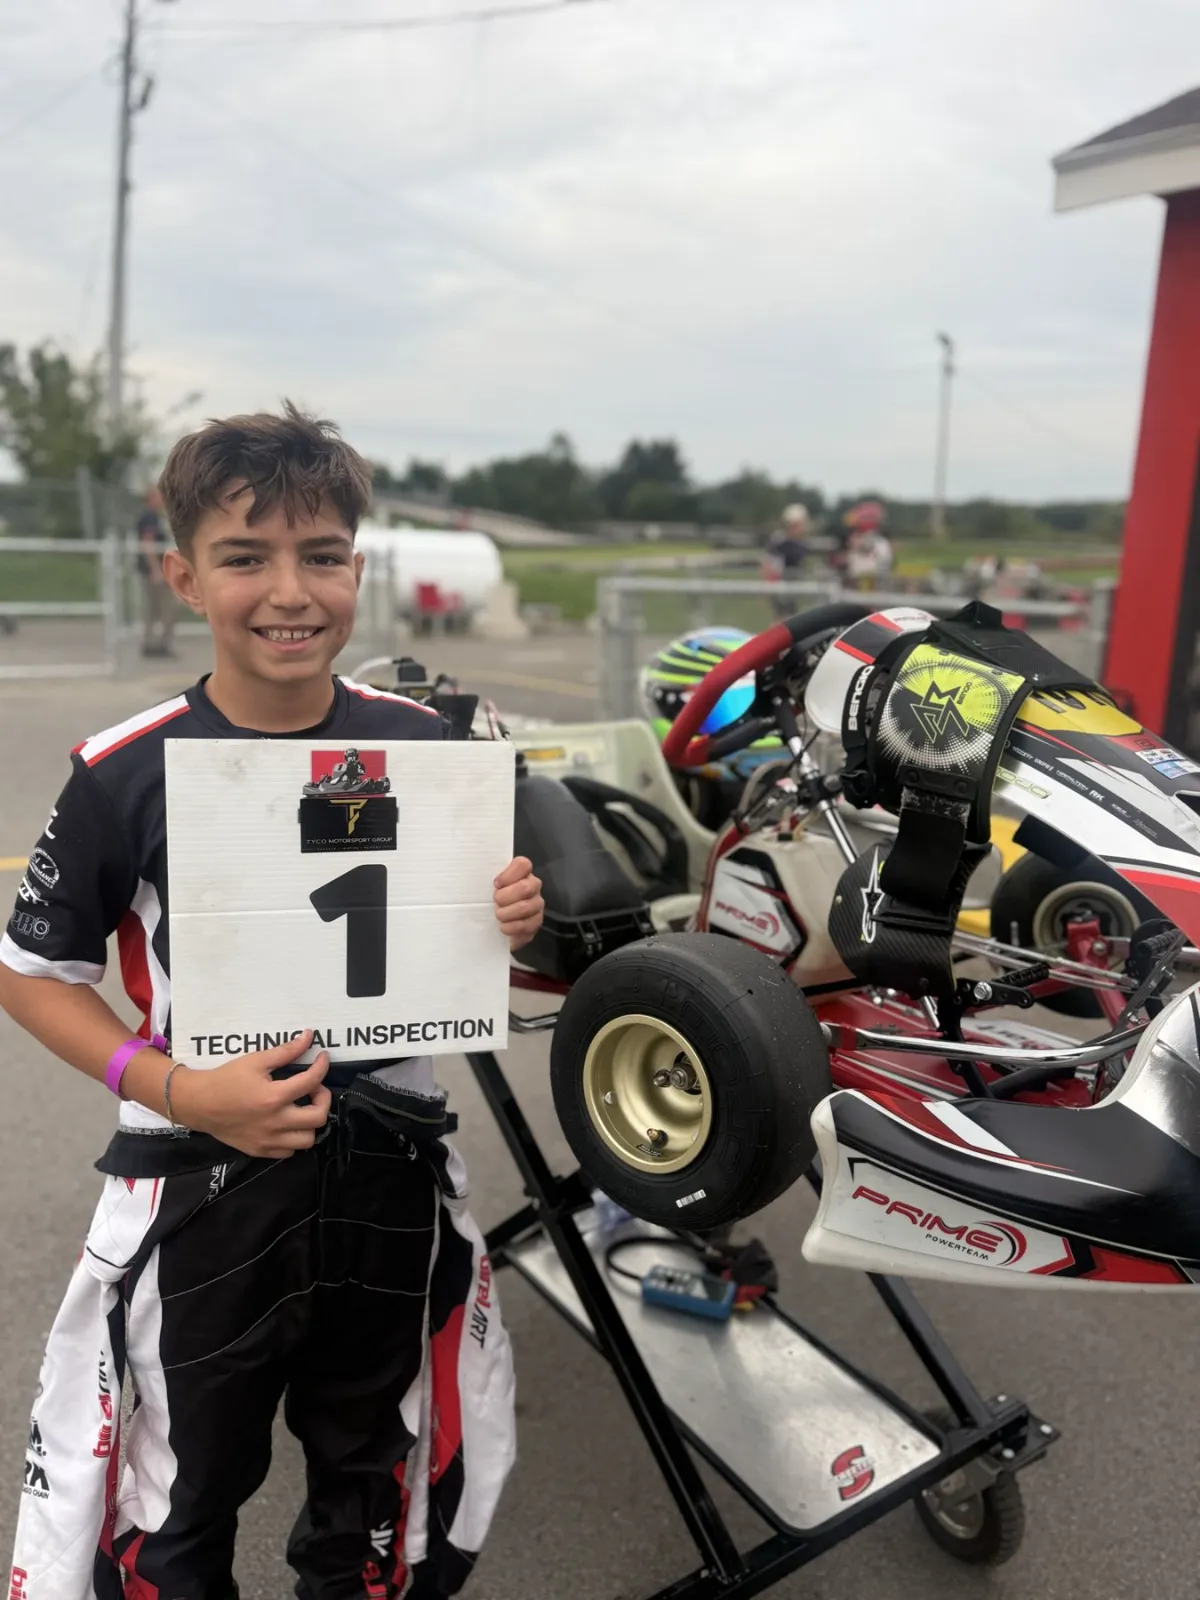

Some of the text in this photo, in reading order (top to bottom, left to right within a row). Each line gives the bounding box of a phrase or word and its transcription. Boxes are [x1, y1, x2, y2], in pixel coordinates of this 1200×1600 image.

[848, 665, 875, 731] BENGIO
[956, 682, 972, 705] BENGIO
[1089, 788, 1104, 802] RK
[309, 864, 387, 998] 1
[346, 1018, 494, 1047] INSPECTION
[852, 1185, 1004, 1253] PRIME
[925, 1233, 989, 1261] POWERTEAM
